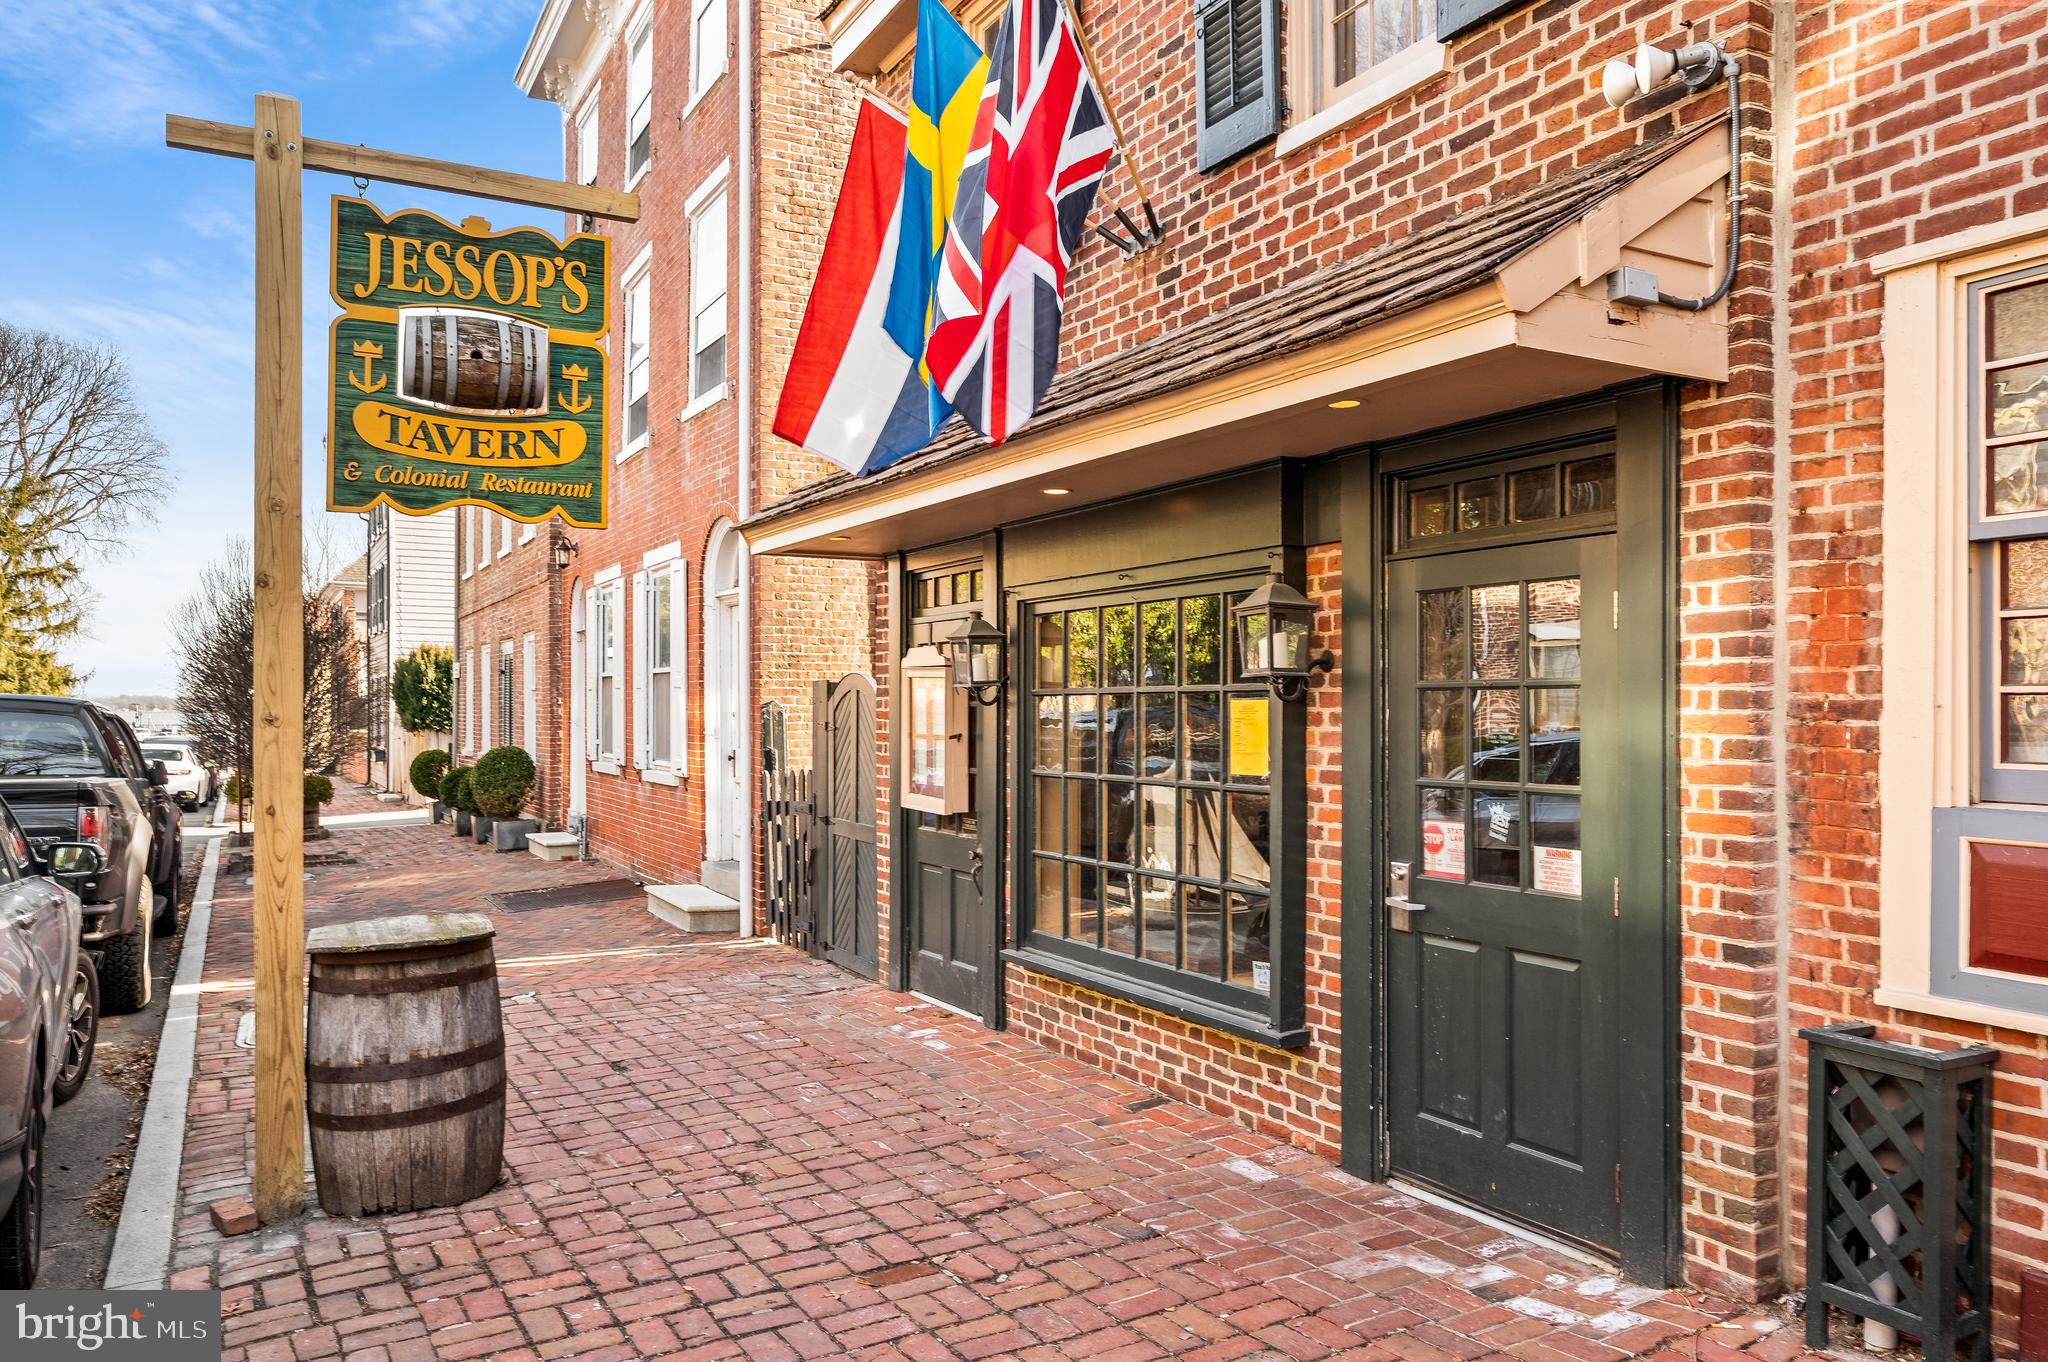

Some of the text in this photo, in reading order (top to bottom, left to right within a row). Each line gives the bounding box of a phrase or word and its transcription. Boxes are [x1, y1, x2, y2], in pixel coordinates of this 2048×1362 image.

[353, 232, 589, 314] JESSOP'S
[378, 409, 565, 460] TAVERN
[343, 462, 593, 499] & Colonial Restaurant
[1424, 833, 1444, 844] STOP
[1545, 848, 1573, 859] WARNING
